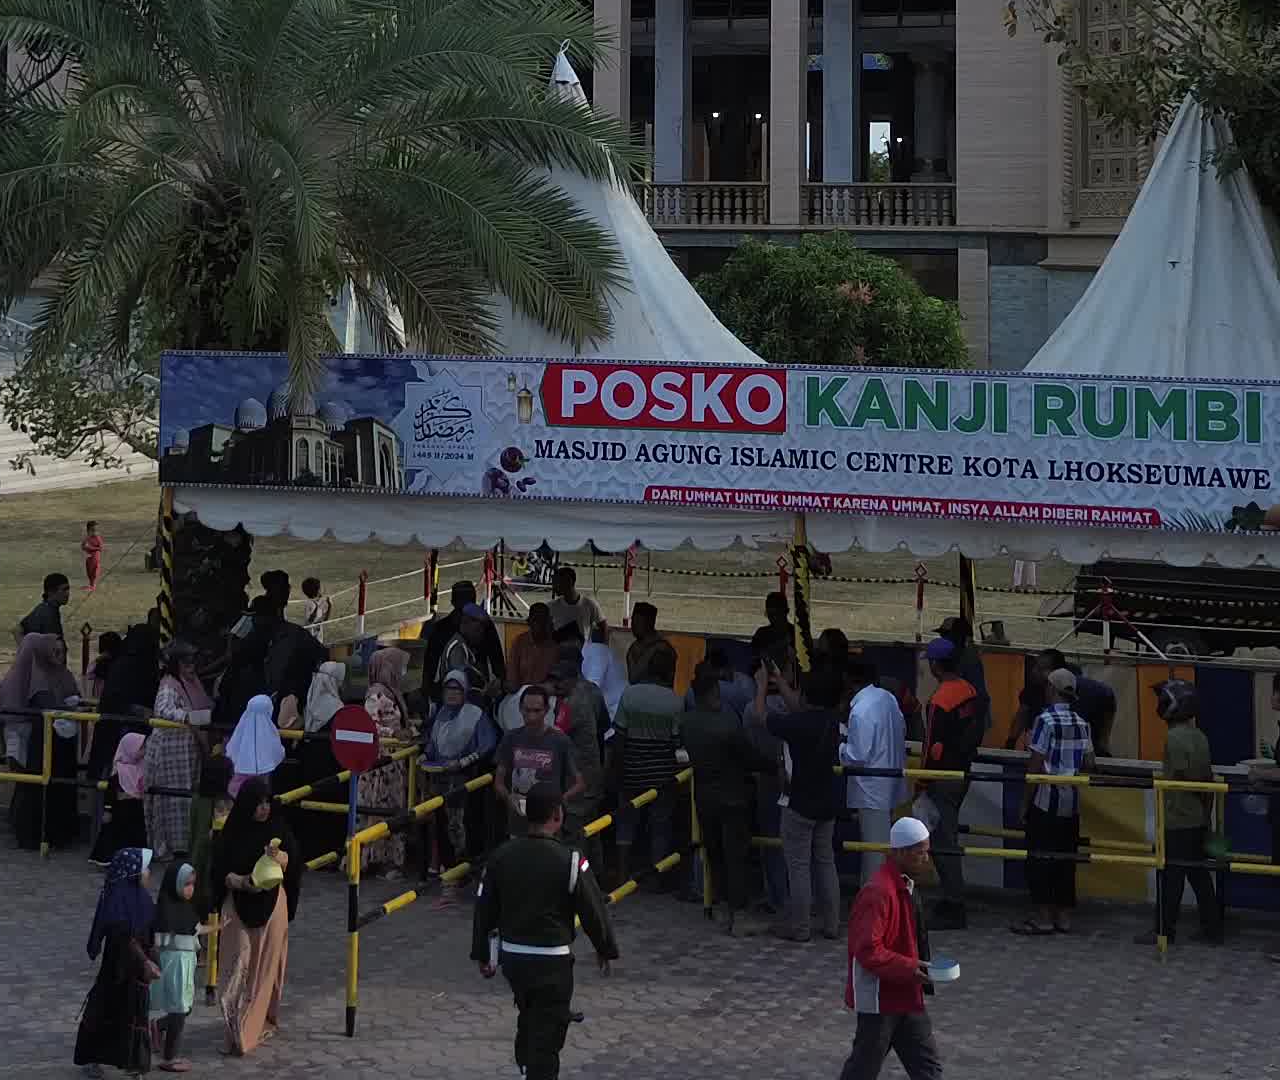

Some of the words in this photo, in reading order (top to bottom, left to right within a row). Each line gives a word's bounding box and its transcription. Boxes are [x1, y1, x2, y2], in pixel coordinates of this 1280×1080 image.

[561, 370, 783, 425] POSKO
[805, 376, 1009, 435] KANJI
[1032, 382, 1263, 444] RUMBI
[535, 439, 627, 461] MASJID
[635, 443, 721, 465] AGUNG
[730, 447, 837, 470] ISLAMIC
[846, 452, 954, 475] CENTRE
[963, 456, 1039, 479] KOTA
[1048, 460, 1270, 490] LHOKSEUMAWE
[651, 489, 682, 500] DARI
[685, 491, 733, 503] UMMAT
[735, 493, 780, 505] UNTUK
[782, 494, 830, 507] UMMAT
[833, 497, 888, 510] KARENA
[892, 500, 945, 514] UMMAT,
[948, 502, 991, 516] INSYA
[993, 505, 1039, 518] ALLAH
[1043, 507, 1088, 521] DIBERI
[1091, 510, 1152, 524] RAHMAT
